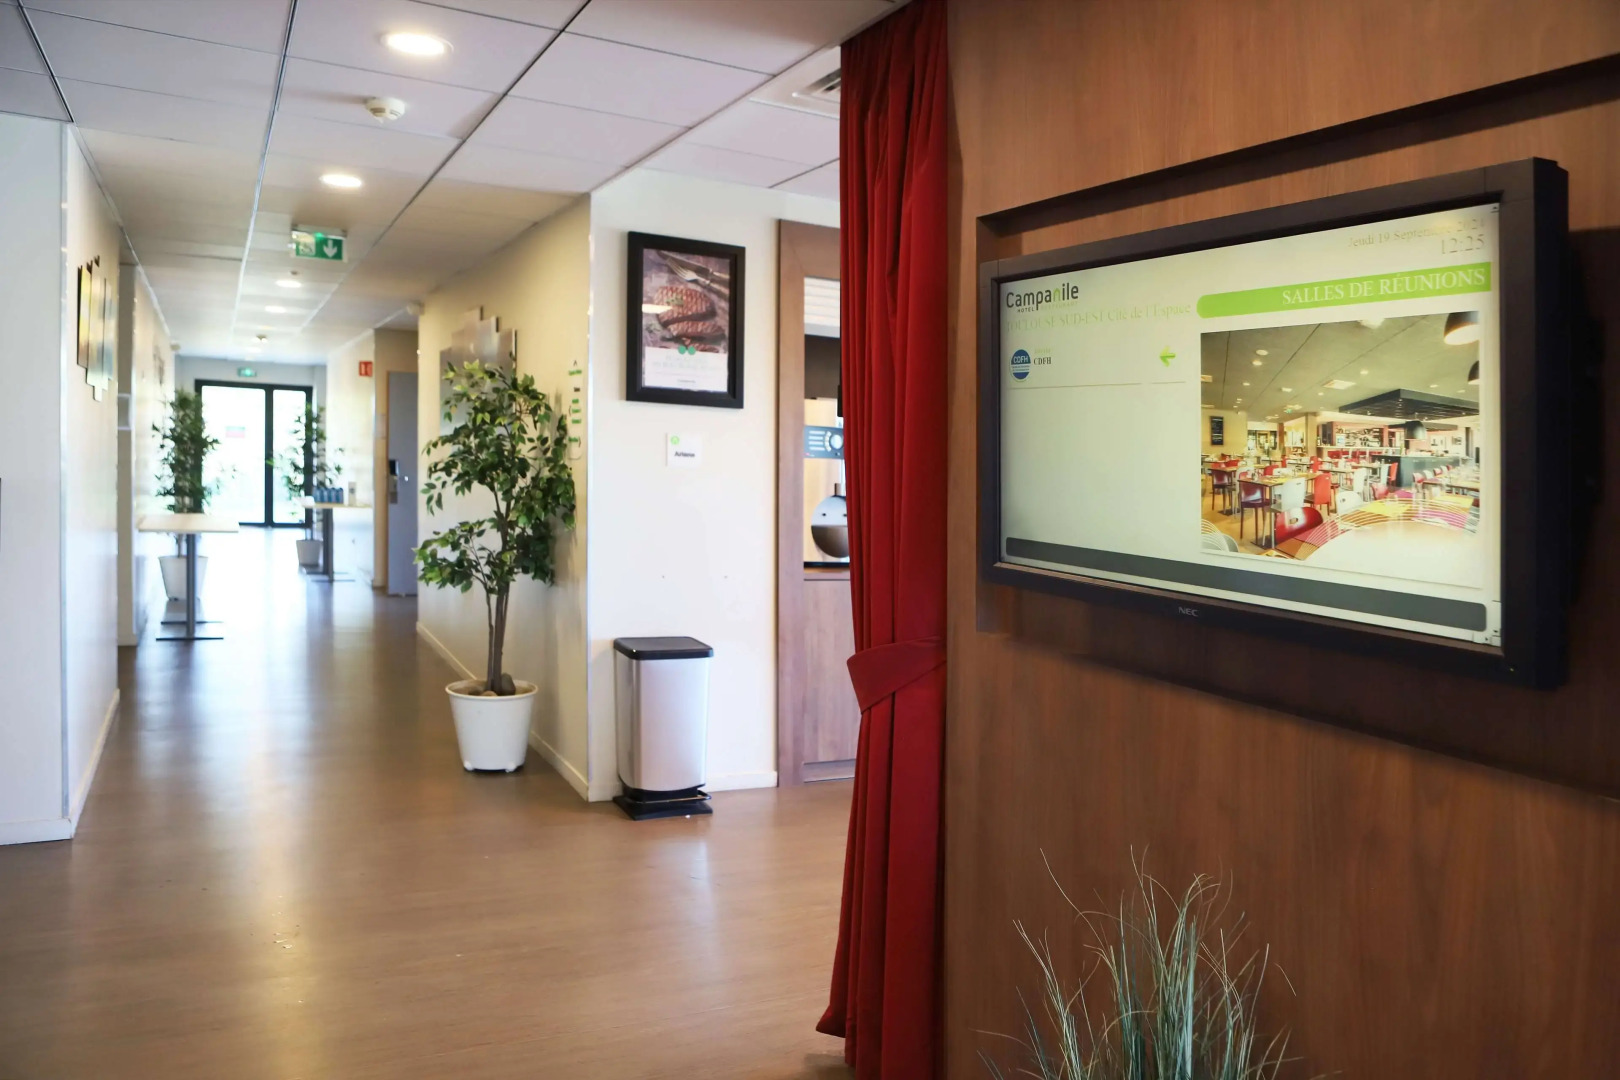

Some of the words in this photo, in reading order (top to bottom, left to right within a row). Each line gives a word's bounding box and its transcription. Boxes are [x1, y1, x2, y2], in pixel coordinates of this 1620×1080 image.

[1348, 233, 1374, 247] Jeudi
[1378, 231, 1390, 244] 19
[1393, 223, 1450, 242] Septem
[1441, 234, 1485, 254] 12:25
[1006, 282, 1079, 311] Campanile
[1282, 284, 1344, 305] SALLES
[1349, 281, 1373, 298] DE
[1379, 268, 1487, 295] RÉUNIONS
[1130, 307, 1143, 319] de
[1033, 356, 1052, 365] CDFH
[1178, 606, 1199, 617] NEC
